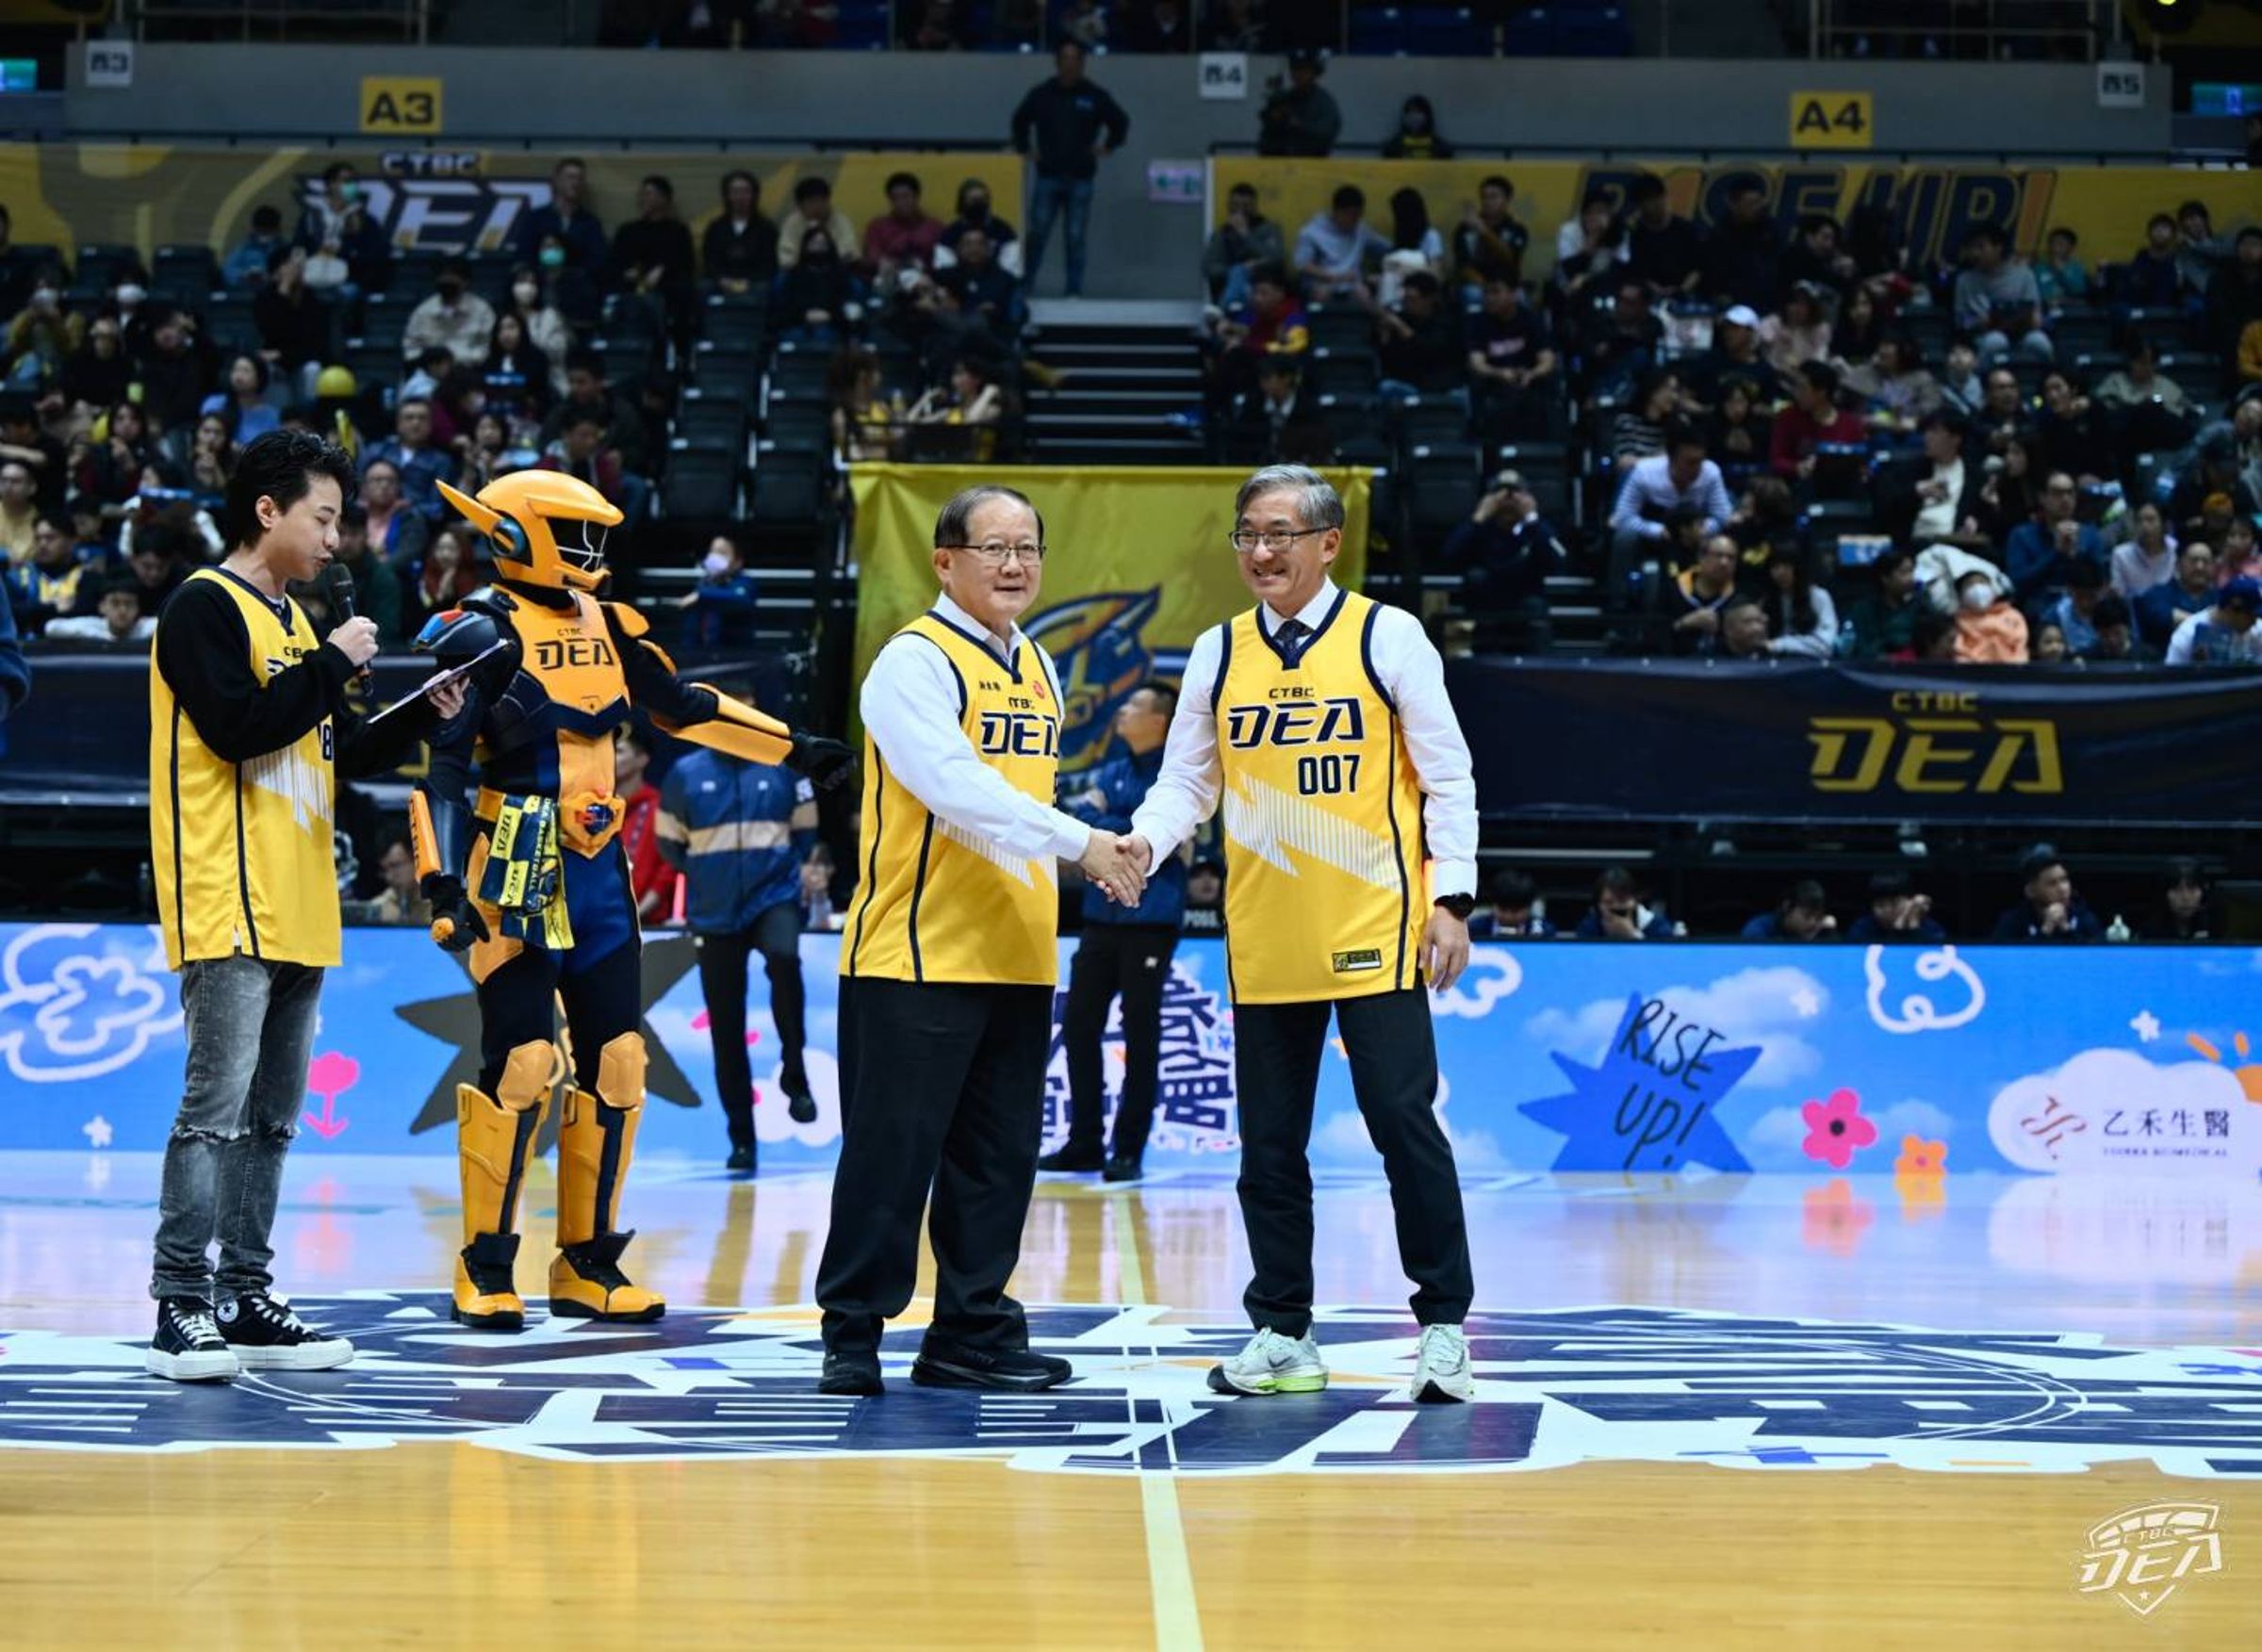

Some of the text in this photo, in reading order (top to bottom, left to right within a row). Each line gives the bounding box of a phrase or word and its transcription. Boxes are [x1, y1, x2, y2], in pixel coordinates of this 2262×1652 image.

[368, 93, 434, 124] A3
[1796, 101, 1865, 133] A4
[382, 152, 477, 174] CTBC
[534, 638, 615, 671] DEA
[1269, 687, 1315, 698] CTBC
[1892, 692, 1979, 712] CTBC
[1228, 698, 1364, 748] DEA
[1808, 717, 2062, 793] DEA
[1298, 755, 1360, 795] 007
[1619, 1000, 1727, 1091] RISE
[1615, 1083, 1705, 1169] UP!
[2103, 1108, 2231, 1138] 乙禾生醫
